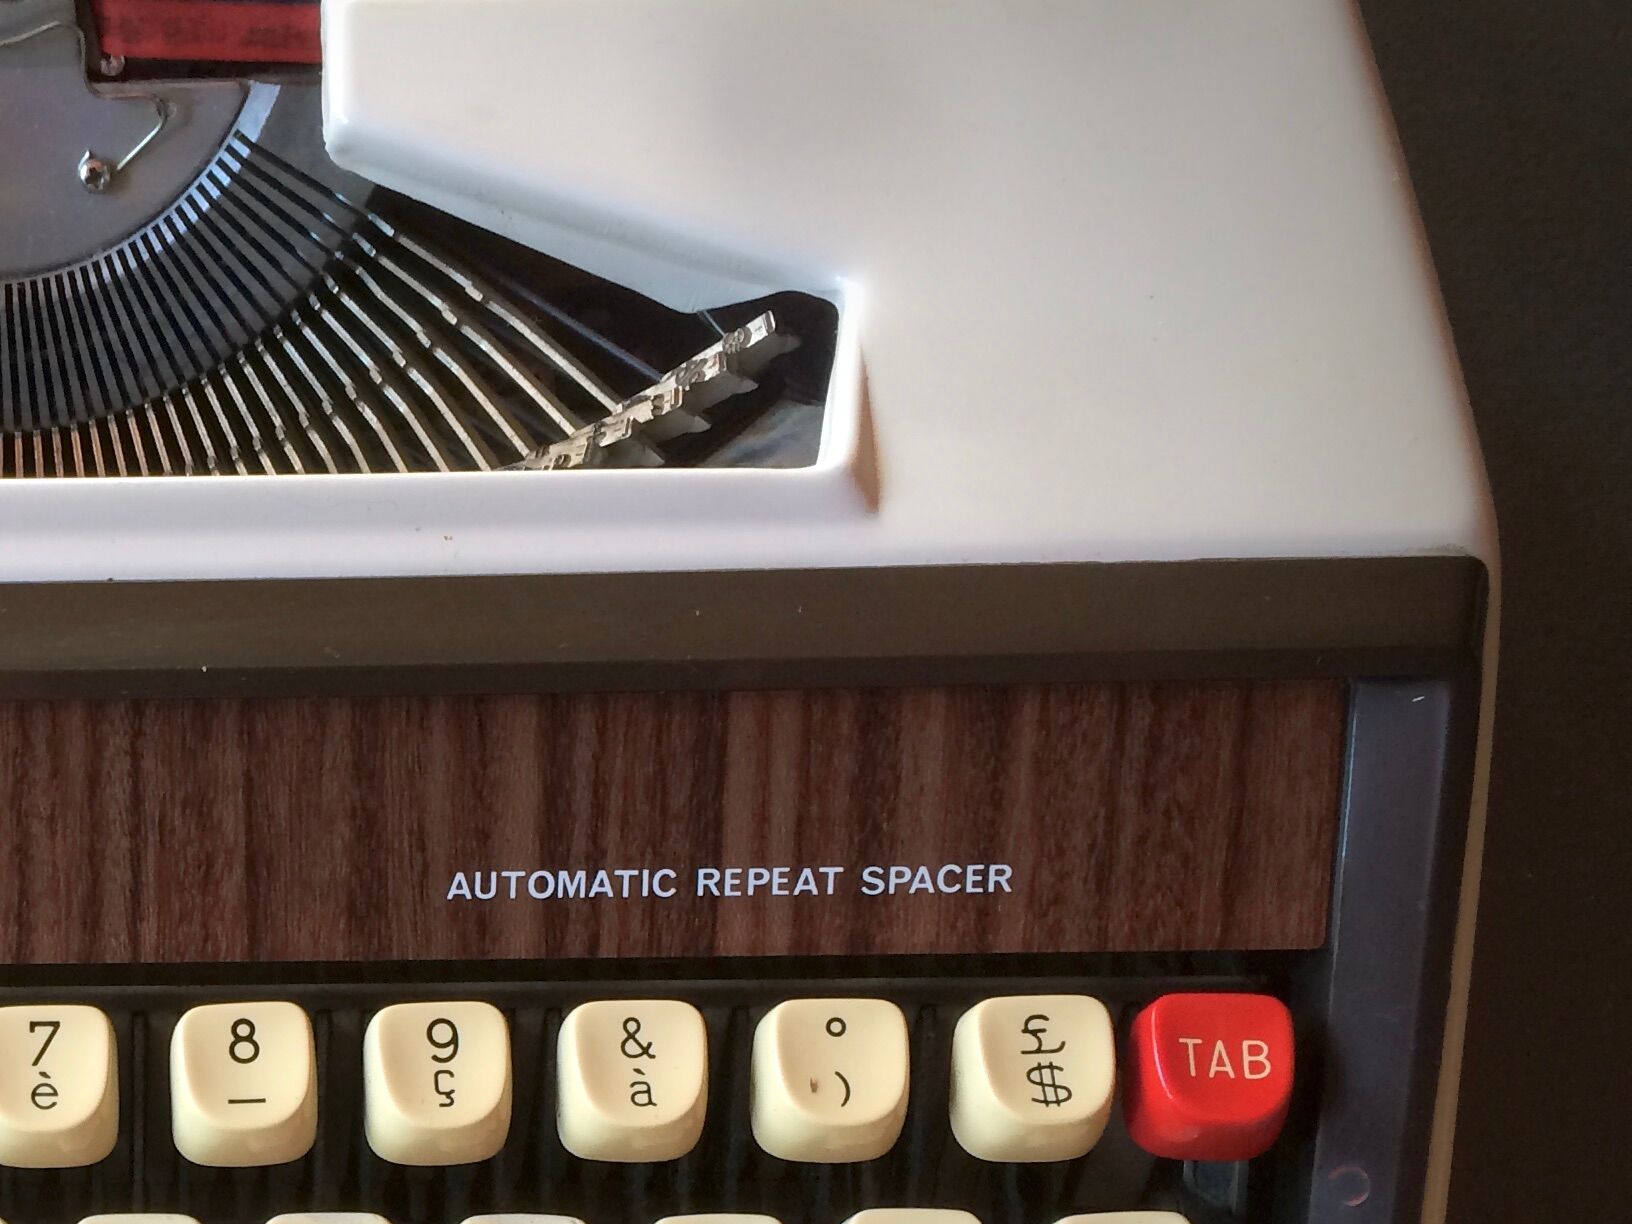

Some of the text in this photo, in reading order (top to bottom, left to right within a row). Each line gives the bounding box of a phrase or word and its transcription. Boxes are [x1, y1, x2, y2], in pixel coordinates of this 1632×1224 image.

[447, 863, 1013, 900] AUTOMATIC REPEAT SPACER
[29, 1021, 60, 1066] 7
[229, 1018, 260, 1064] 8
[426, 1018, 459, 1061] 9
[621, 1017, 656, 1059] &
[1021, 1014, 1065, 1054] £
[1179, 1037, 1271, 1080] TAB
[31, 1071, 58, 1110] è
[434, 1070, 455, 1107] ç
[630, 1068, 657, 1107] à
[834, 1072, 851, 1108] )
[1026, 1061, 1072, 1107] $
